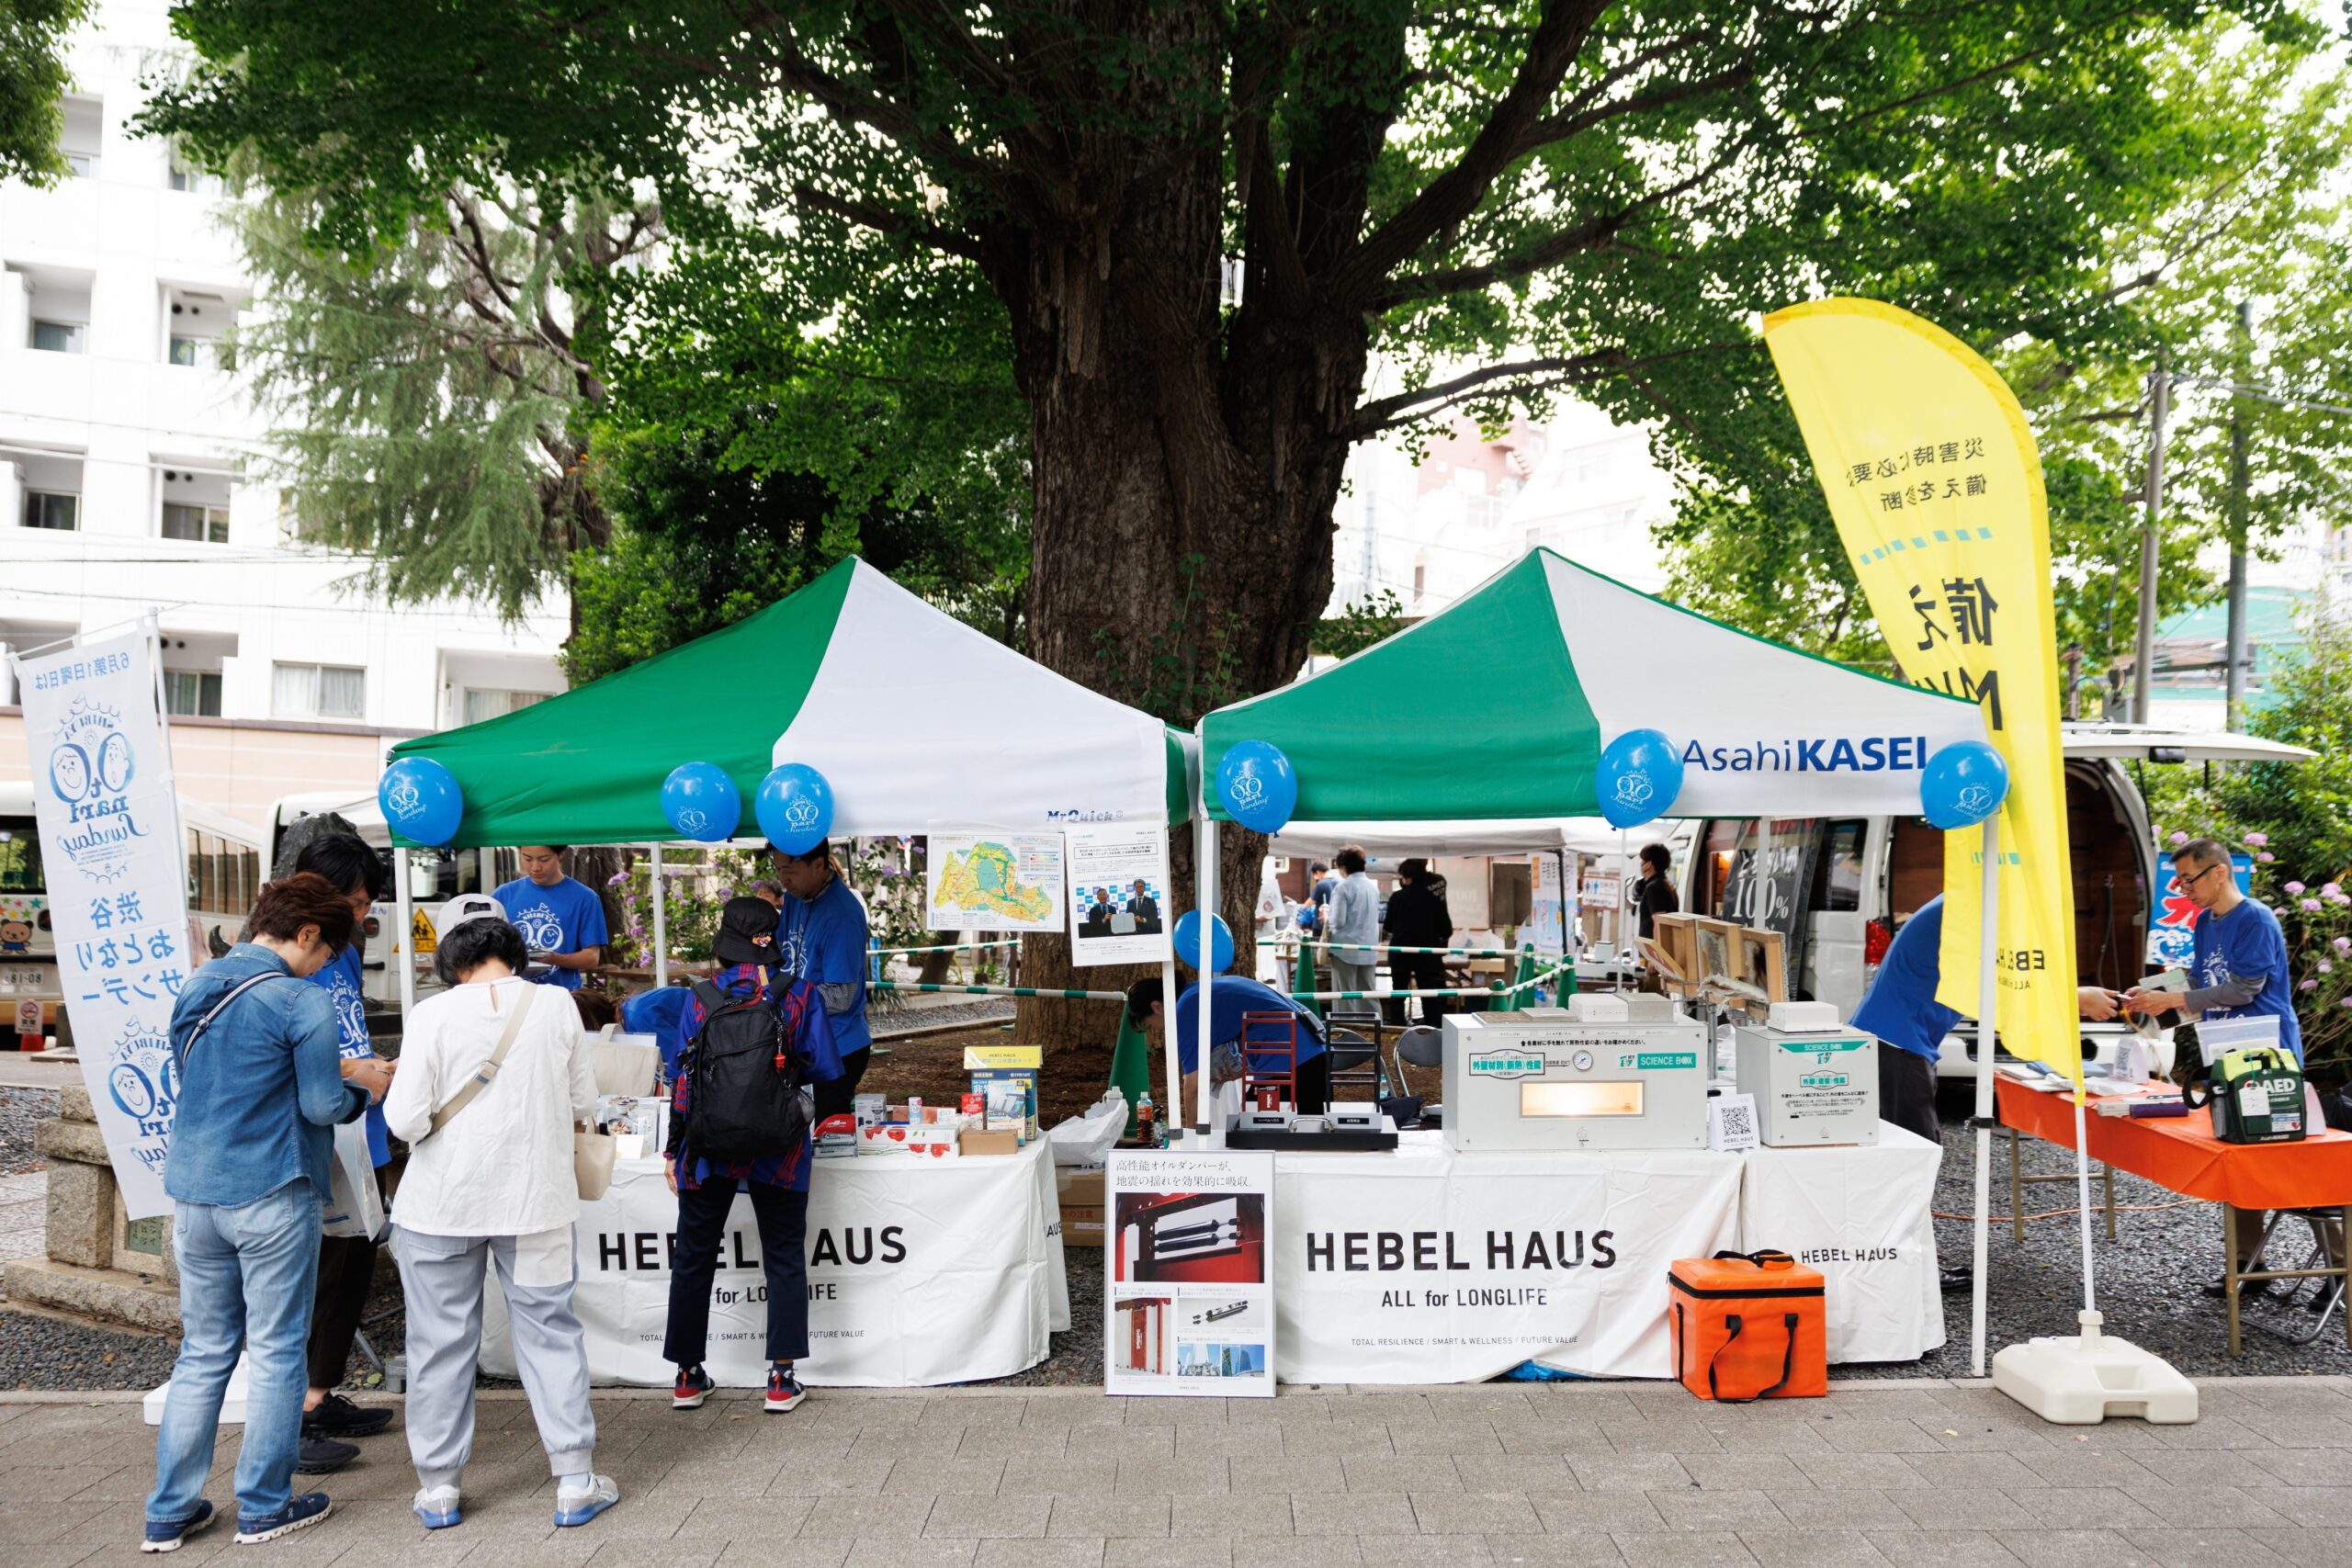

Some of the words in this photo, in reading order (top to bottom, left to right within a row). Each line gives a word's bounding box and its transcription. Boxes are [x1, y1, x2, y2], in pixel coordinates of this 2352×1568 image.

[1804, 1043, 1828, 1052] SCIENCE
[1641, 1056, 1672, 1066] SCIENCE
[2262, 1078, 2296, 1094] AED
[599, 1231, 759, 1271] HEL
[810, 1226, 907, 1267] AUS
[1307, 1232, 1470, 1271] HEBEL
[1487, 1230, 1616, 1269] HAUS
[1802, 1249, 1850, 1263] HEBEL
[1856, 1248, 1897, 1261] HAUS
[716, 1287, 739, 1303] for
[747, 1284, 837, 1303] LOIFE
[1382, 1291, 1416, 1307] ALL
[1426, 1290, 1449, 1306] for
[1457, 1289, 1547, 1306] LONGLIFE
[1555, 1336, 1578, 1344] VALUE
